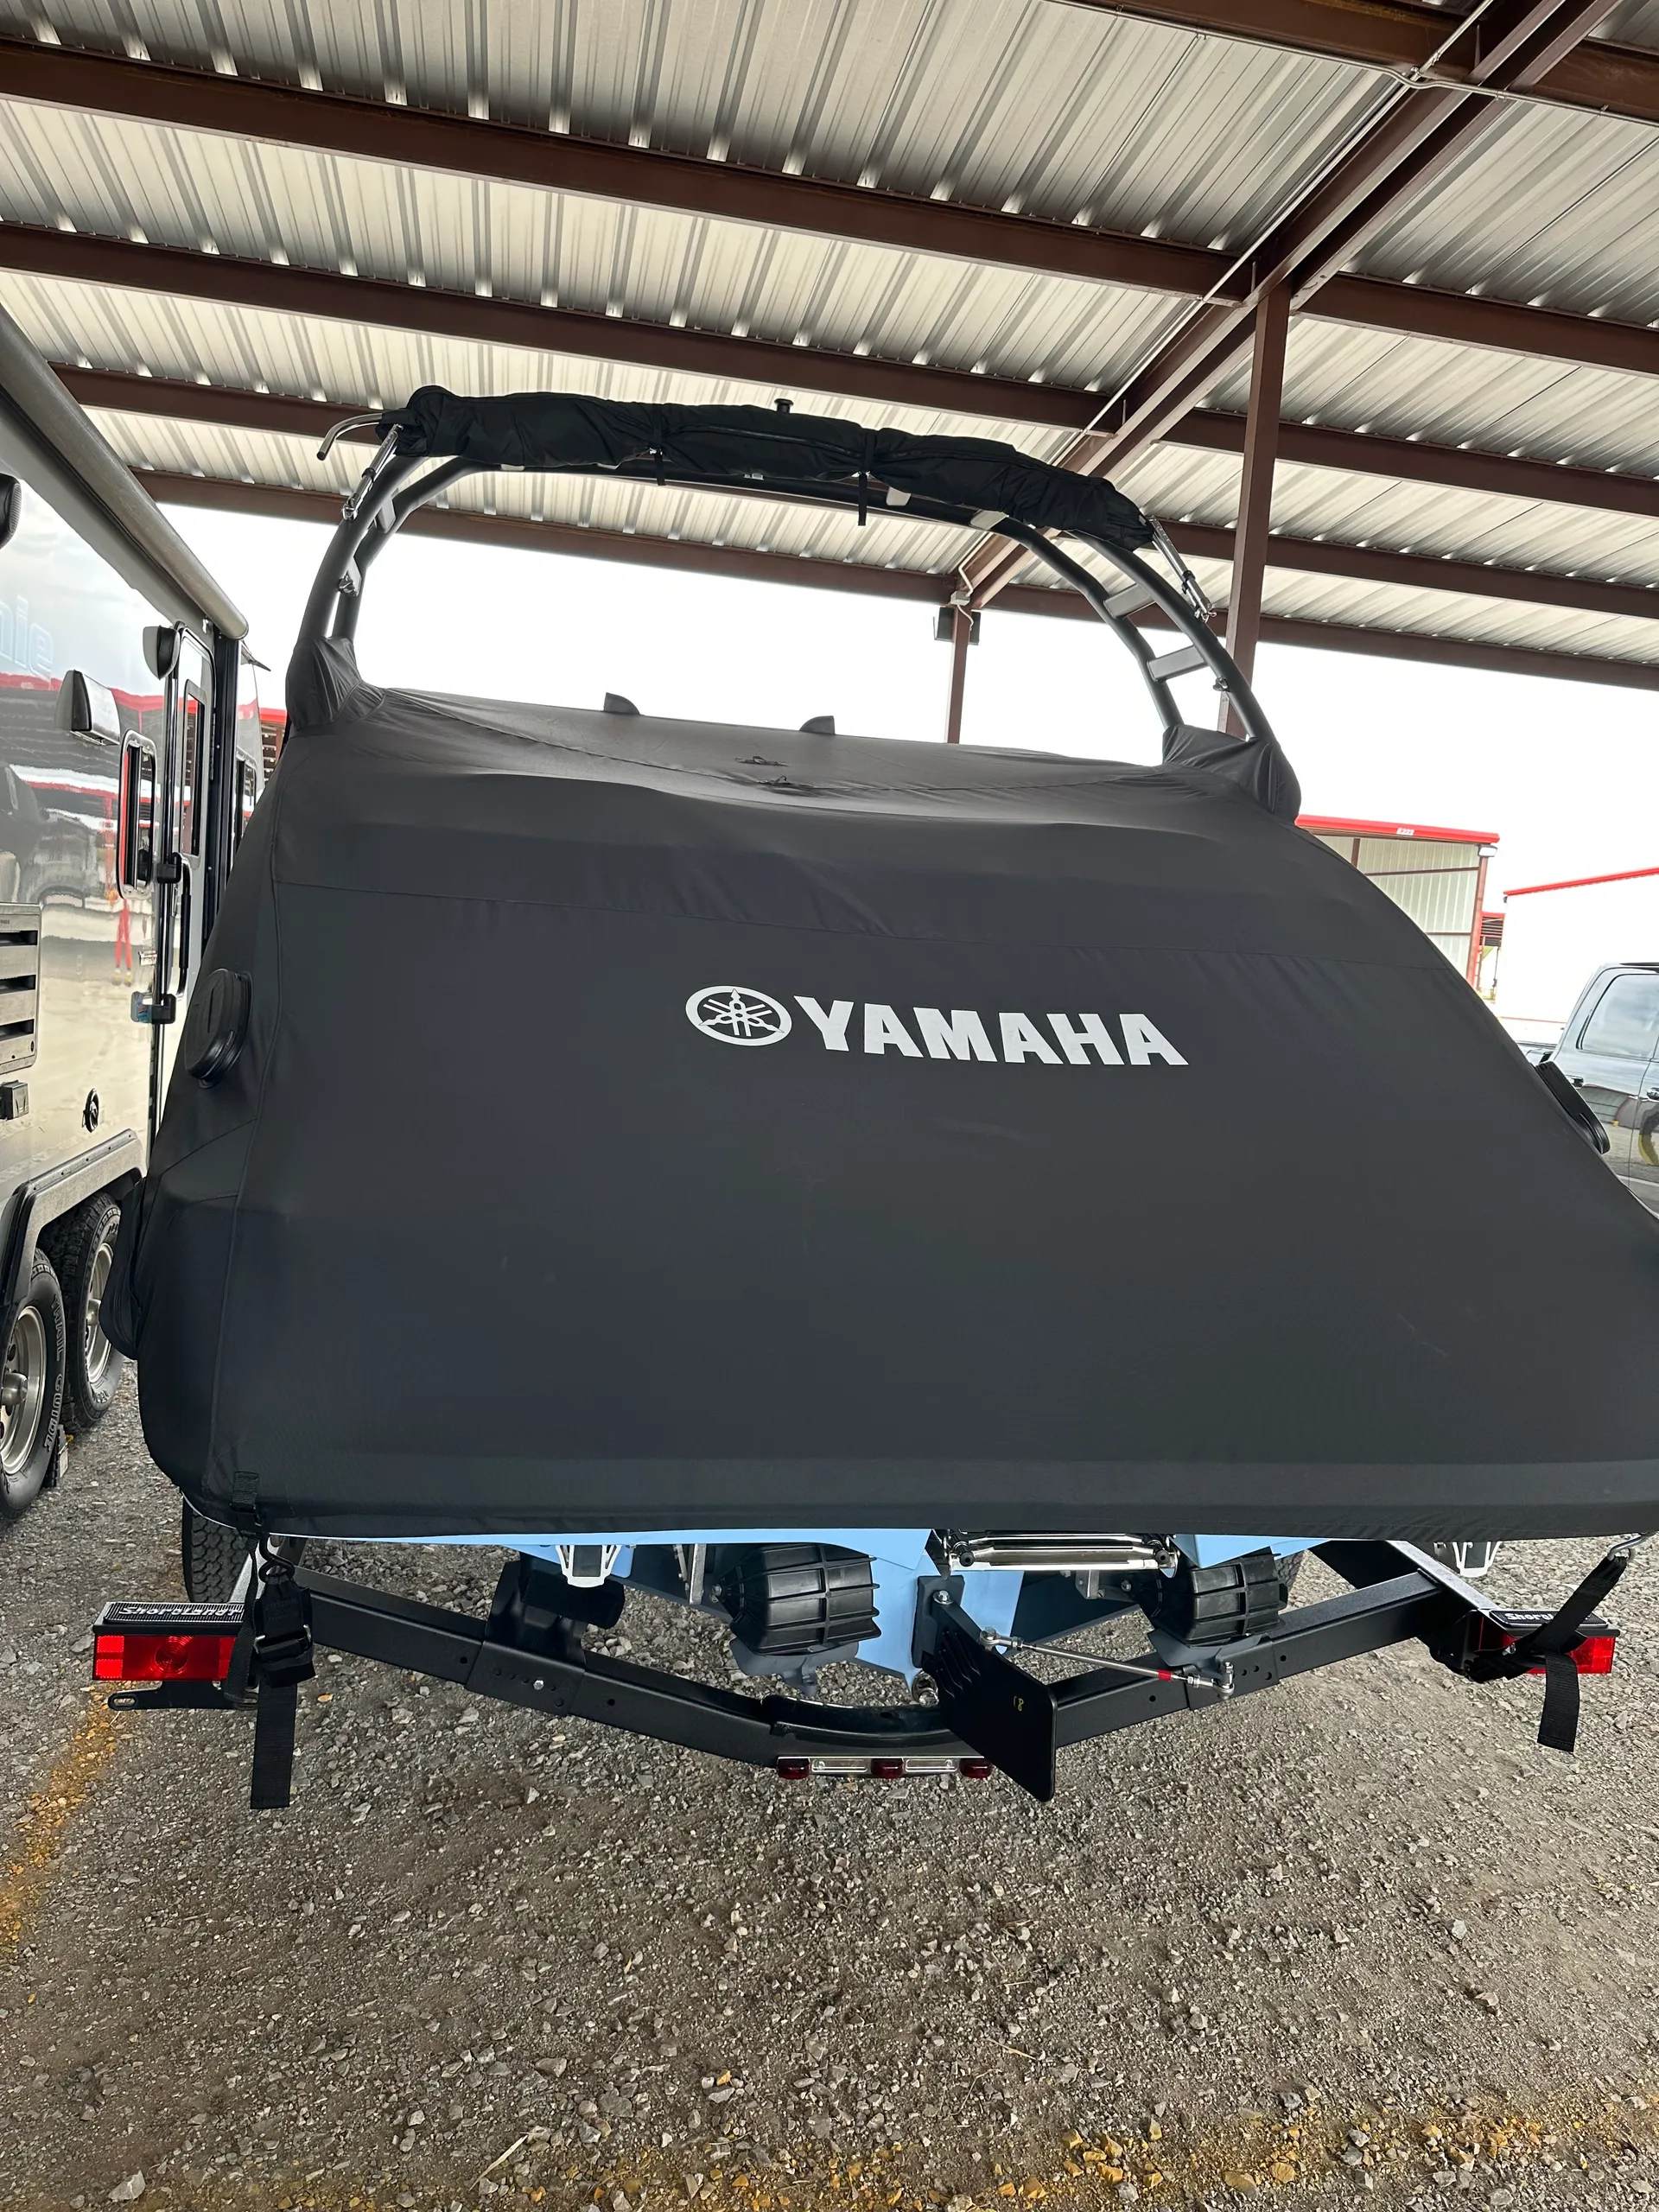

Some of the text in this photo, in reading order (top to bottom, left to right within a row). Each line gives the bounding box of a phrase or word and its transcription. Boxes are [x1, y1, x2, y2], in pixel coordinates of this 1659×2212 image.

[793, 995, 1189, 1066] YAMAHA
[44, 1294, 65, 1452] TRAIL GUIDE
